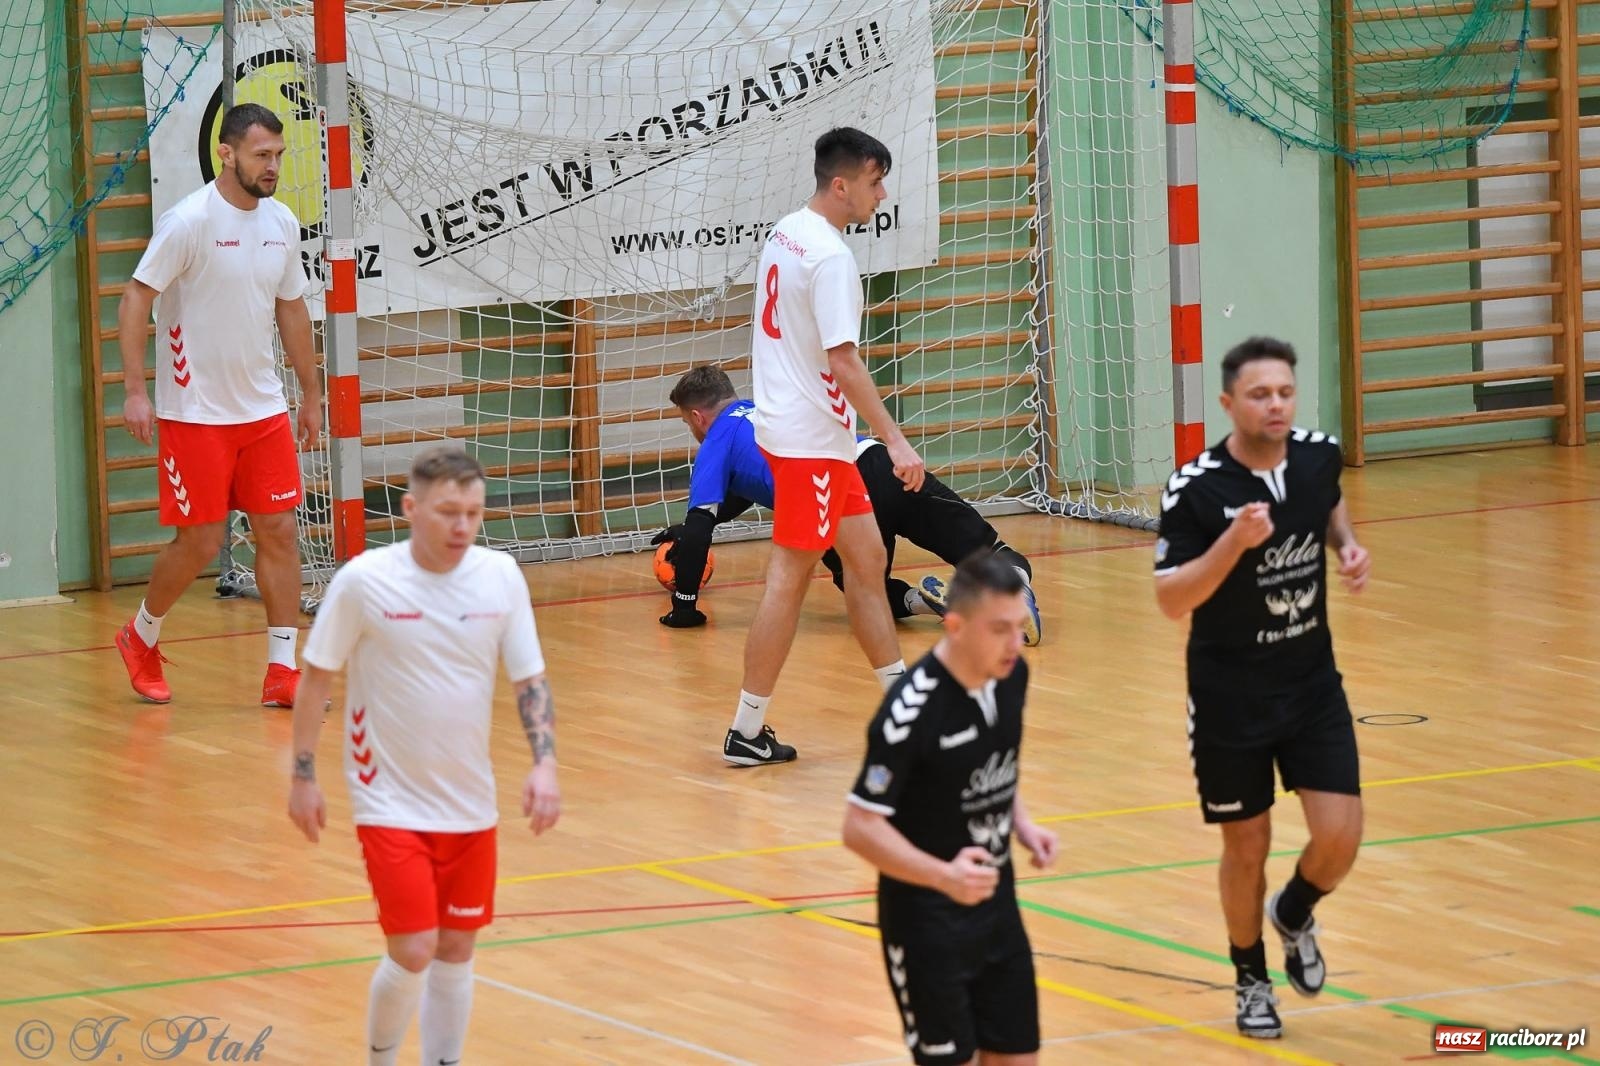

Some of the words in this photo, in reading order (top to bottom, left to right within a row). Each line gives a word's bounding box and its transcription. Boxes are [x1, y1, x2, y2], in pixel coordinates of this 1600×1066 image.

[413, 172, 530, 259] JEST
[543, 152, 594, 200] W
[761, 263, 782, 340] 8
